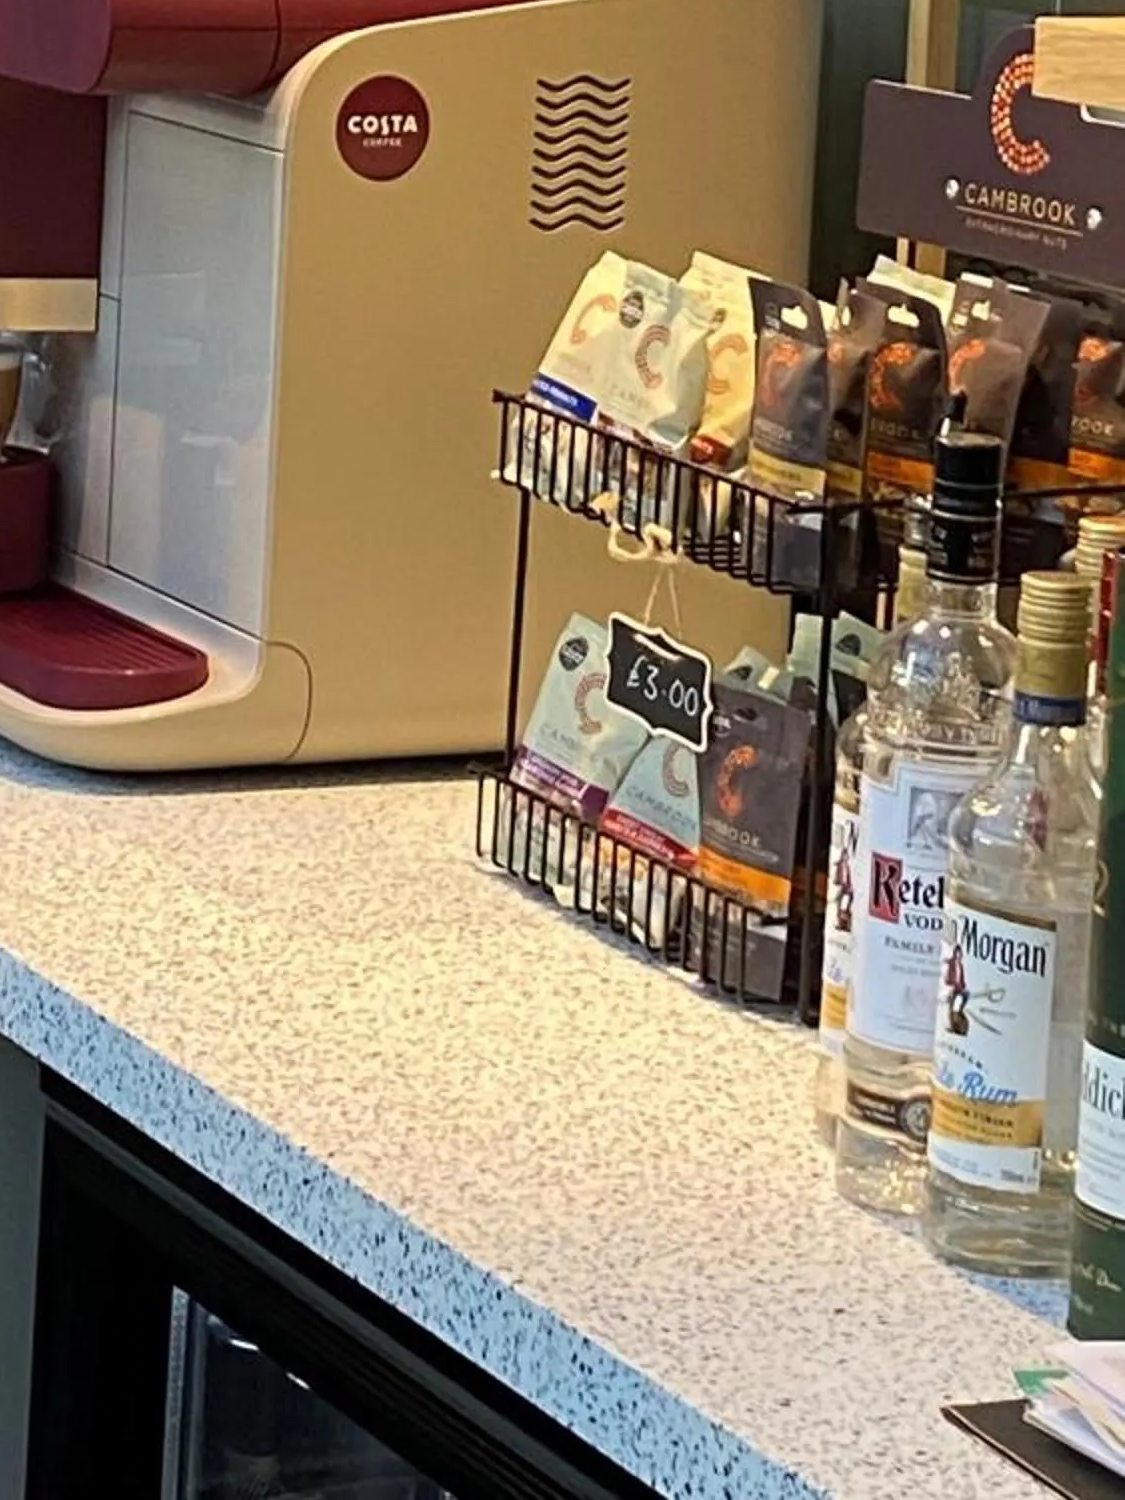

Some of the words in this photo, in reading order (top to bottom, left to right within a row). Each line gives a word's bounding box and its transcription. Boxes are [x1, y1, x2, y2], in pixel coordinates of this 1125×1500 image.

[347, 114, 418, 136] COSTA
[964, 183, 1076, 226] CAMBROOK
[627, 655, 699, 717] £3.00
[874, 860, 945, 917] Ketel
[904, 913, 944, 931] VOD
[959, 915, 1047, 978] Morgan
[958, 1071, 1018, 1107] Rum
